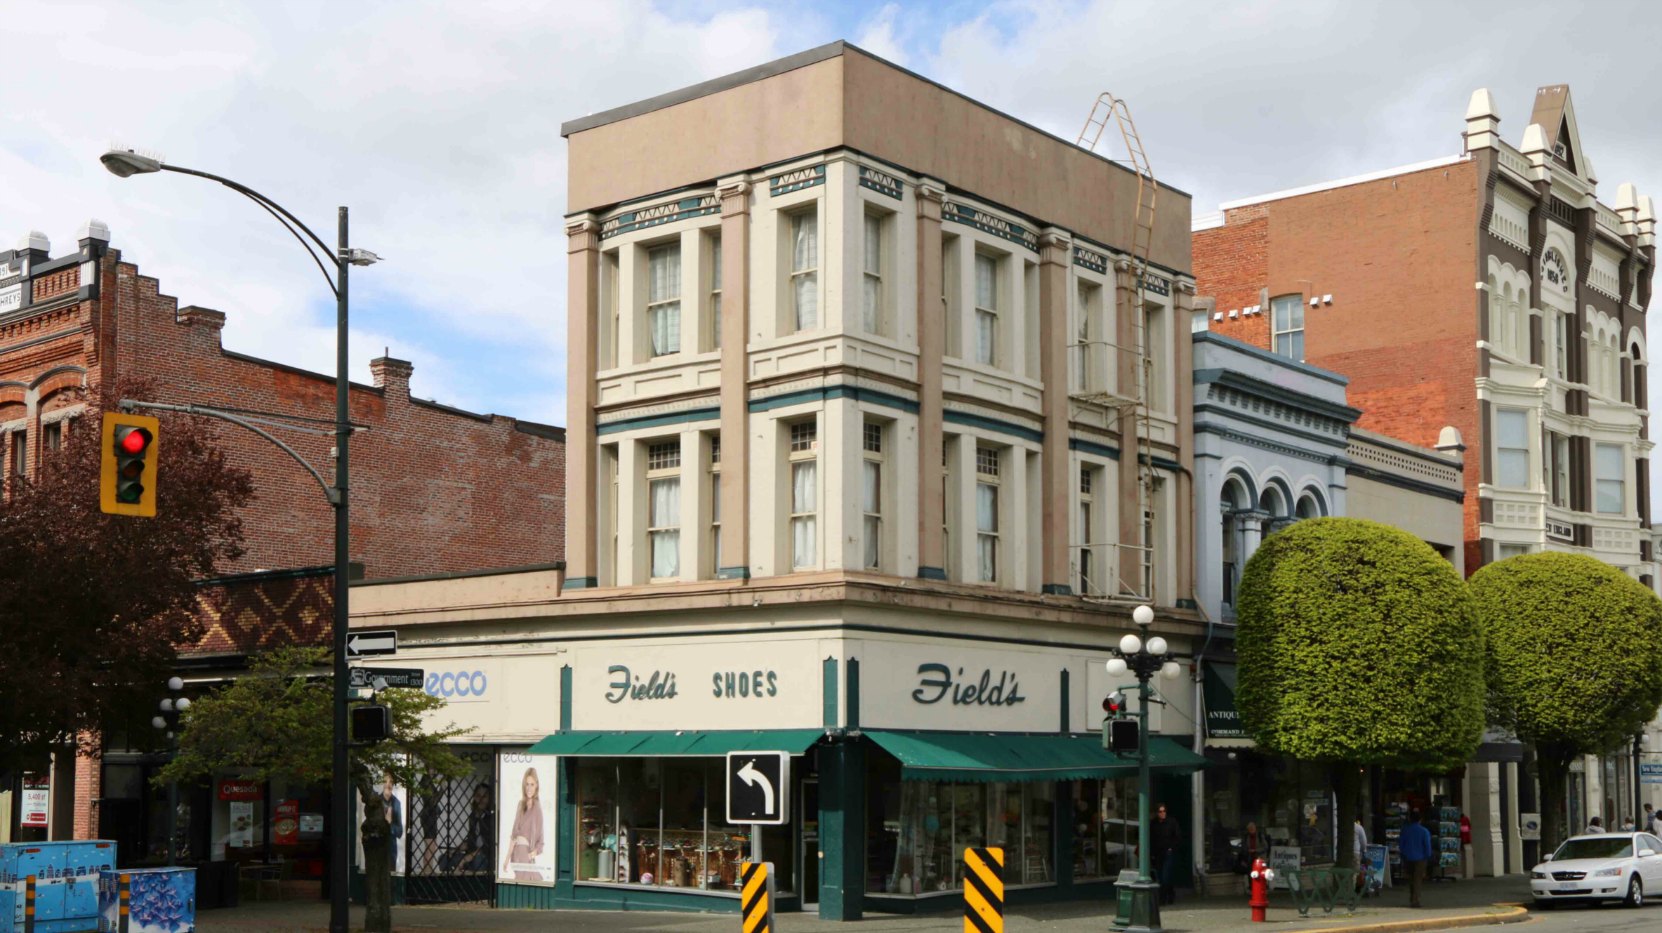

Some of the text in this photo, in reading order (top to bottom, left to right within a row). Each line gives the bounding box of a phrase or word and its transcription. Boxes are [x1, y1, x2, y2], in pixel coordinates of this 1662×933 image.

[0, 292, 21, 306] HREYS
[1553, 524, 1572, 537] ENGLAND
[364, 671, 409, 685] Govrnment
[425, 670, 487, 697] ecco
[604, 664, 778, 704] Field's SHOES
[911, 662, 1026, 706] Field's
[503, 752, 533, 763] ecco
[223, 784, 258, 794] Quesada
